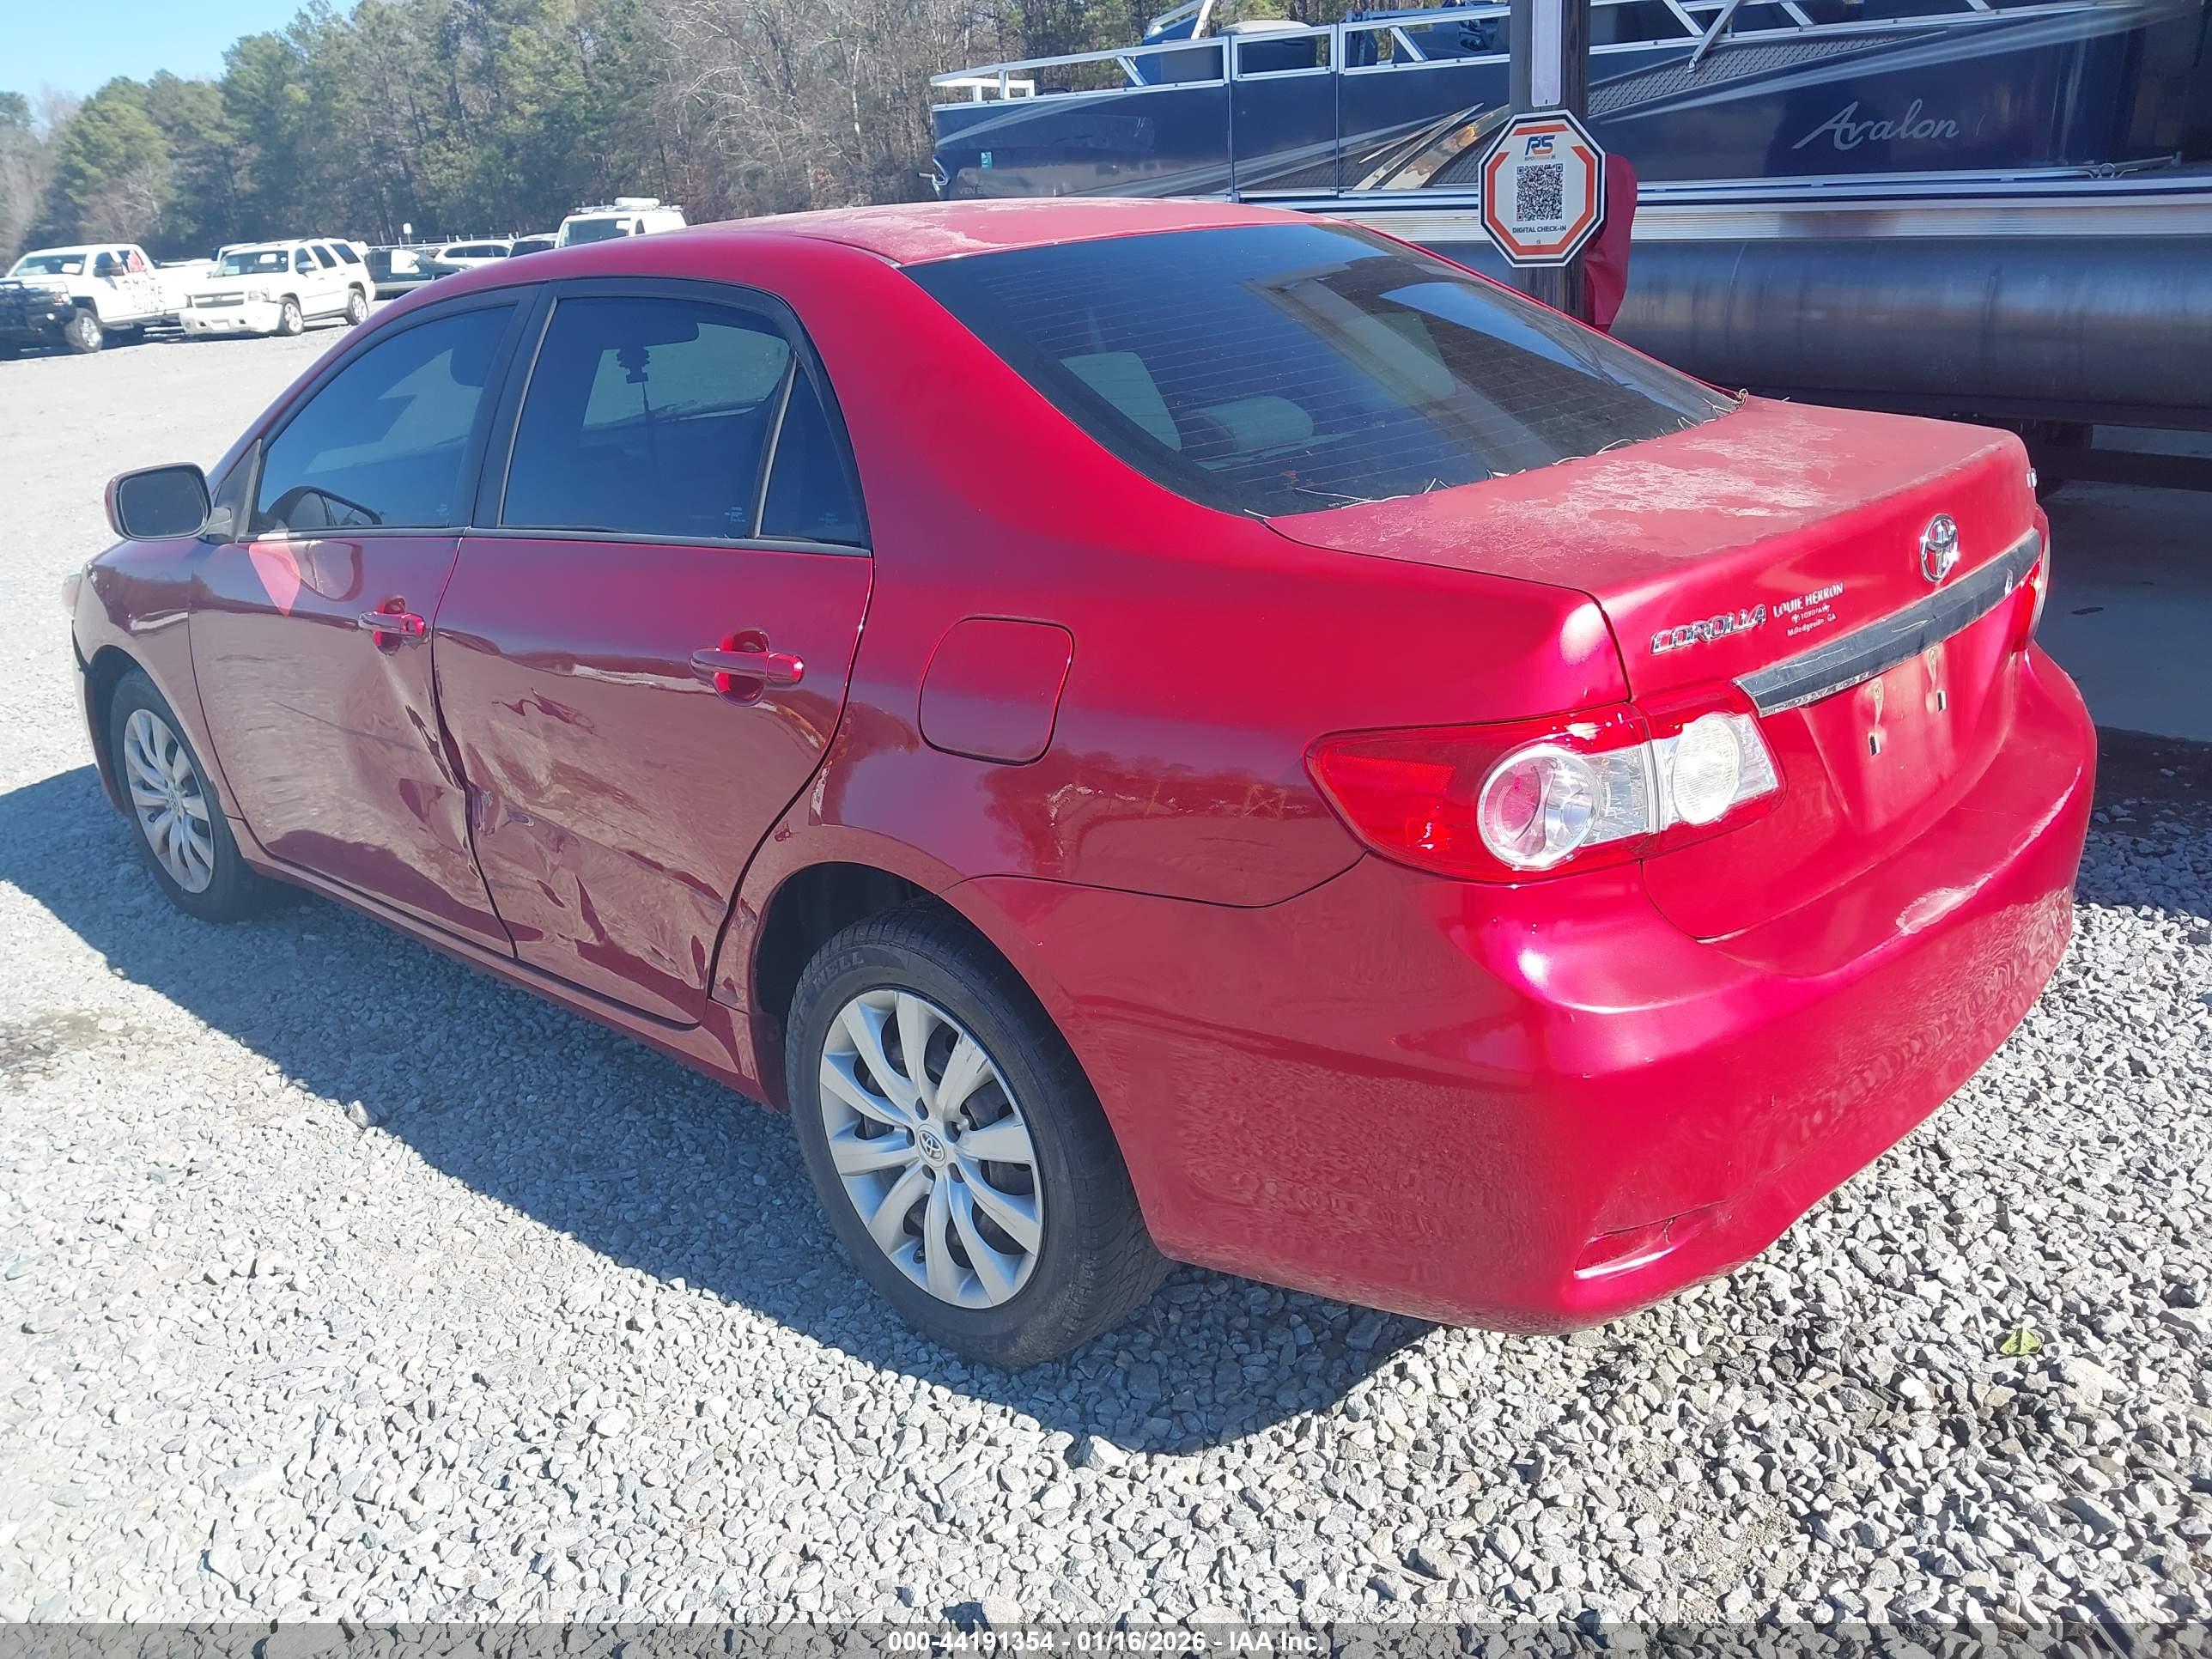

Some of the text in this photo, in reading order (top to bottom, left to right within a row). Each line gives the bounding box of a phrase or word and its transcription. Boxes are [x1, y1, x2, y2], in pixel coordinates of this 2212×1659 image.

[1791, 98, 1960, 150] Avalon
[1772, 582, 1843, 618] LOUIE HERRON
[1801, 608, 1823, 620] TOYOTA
[1827, 613, 1836, 622] GA
[1650, 604, 1767, 653] COROLLA
